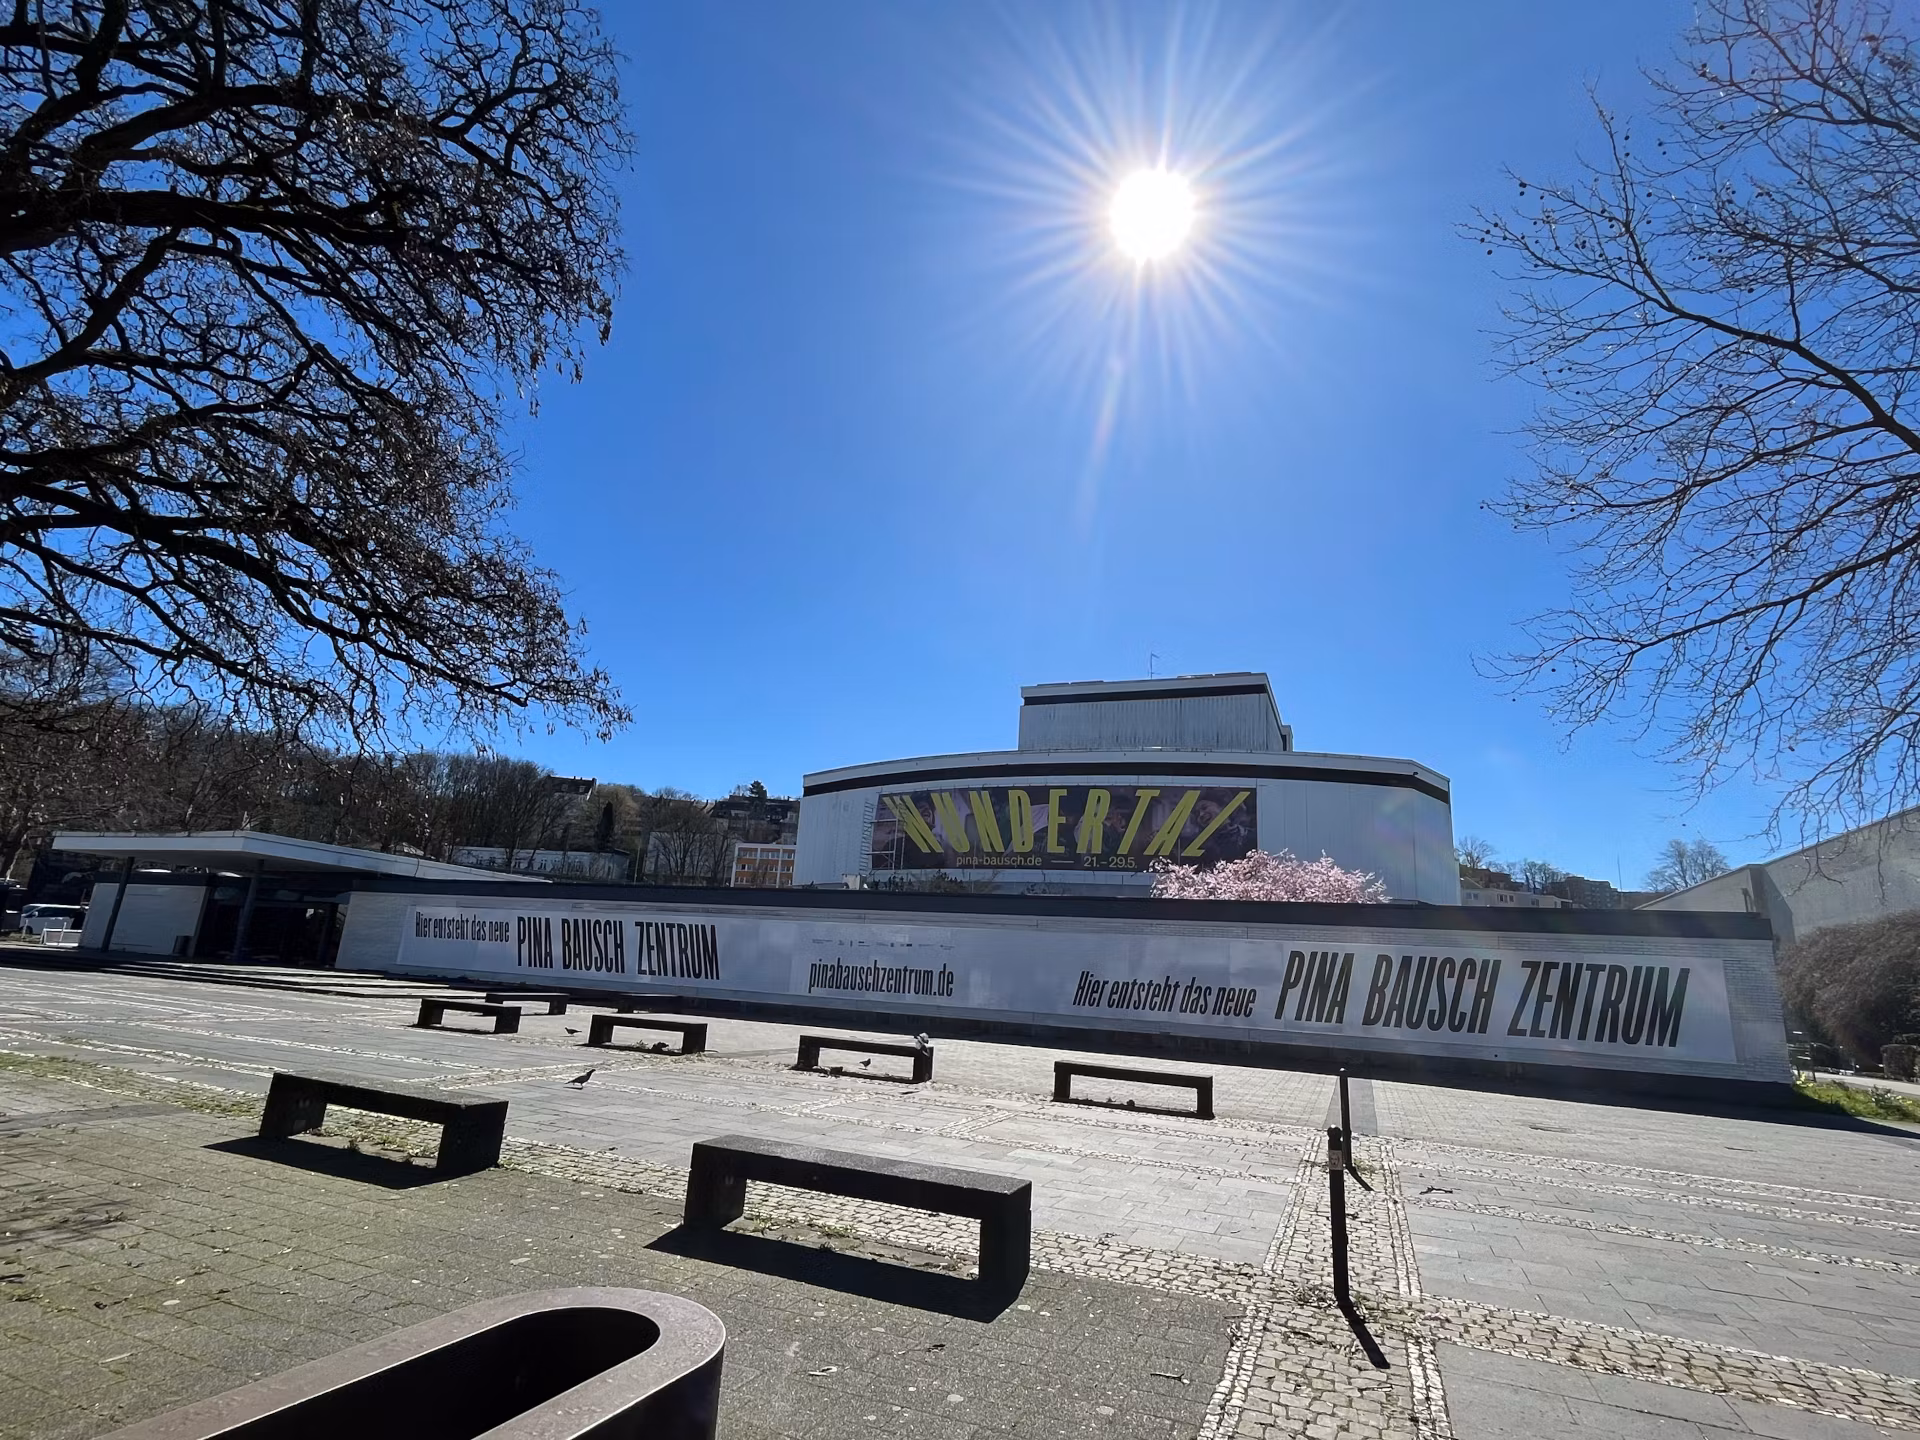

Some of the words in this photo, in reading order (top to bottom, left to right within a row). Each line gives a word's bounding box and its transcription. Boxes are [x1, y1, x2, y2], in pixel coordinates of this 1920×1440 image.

[956, 854, 1042, 868] pina-bausch.de
[415, 911, 433, 937] Hier
[433, 913, 469, 940] entsteht
[471, 914, 487, 941] das
[488, 920, 510, 942] neue
[517, 916, 553, 968] PINA
[561, 918, 625, 974] BAUSCH
[635, 921, 720, 980] ZENTRUM
[808, 957, 954, 997] pinabauschzentrum.de
[1072, 970, 1109, 1008] Hier
[1107, 975, 1180, 1012] entsteht
[1179, 976, 1212, 1015] das
[1212, 987, 1257, 1018] neue
[1274, 950, 1355, 1024] PINA
[1361, 954, 1501, 1035] BAUSCH
[1507, 960, 1690, 1047] ZENTRUM
